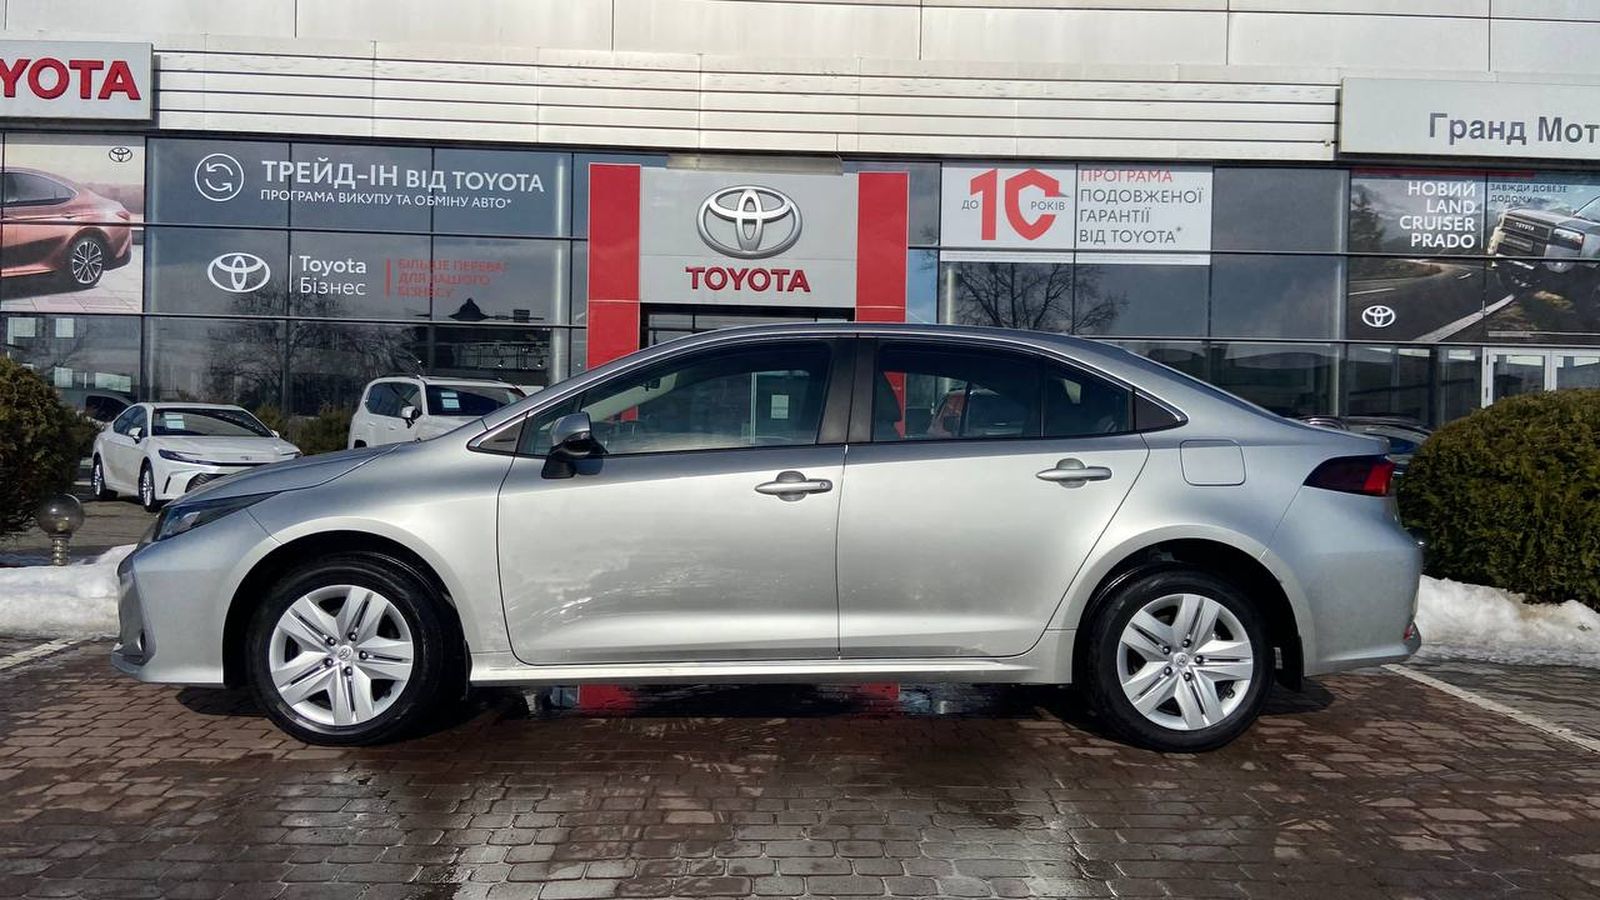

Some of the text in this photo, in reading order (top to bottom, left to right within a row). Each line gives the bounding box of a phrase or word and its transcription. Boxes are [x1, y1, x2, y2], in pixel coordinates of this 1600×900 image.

[1429, 112, 1600, 146] Гранд Мот
[261, 156, 545, 193] ТРЕЙД-ІН ВІД TOYOTA
[1079, 168, 1173, 183] ПРОГРАМА
[1080, 187, 1205, 205] ПОДОВЖЕНОЇ
[1408, 179, 1476, 197] НОВИЙ
[1490, 183, 1530, 193] ЗАВЖДИ
[260, 189, 335, 203] ПРОГРАМА
[338, 192, 393, 205] ВИКУПУ
[395, 194, 412, 206] ТА
[414, 195, 469, 208] ОБМІНУ
[961, 199, 979, 210] ДО
[1030, 200, 1066, 211] РОКІВ
[1426, 199, 1475, 214] LAND
[1079, 207, 1152, 223] ГАРАНТІЇ
[1399, 215, 1476, 232] CRUISER
[1079, 229, 1106, 245] ВІД
[1410, 232, 1475, 249] PRADO
[299, 255, 367, 277] Toyota
[300, 276, 367, 296] Бізнес
[685, 266, 811, 293] TOYOTA
